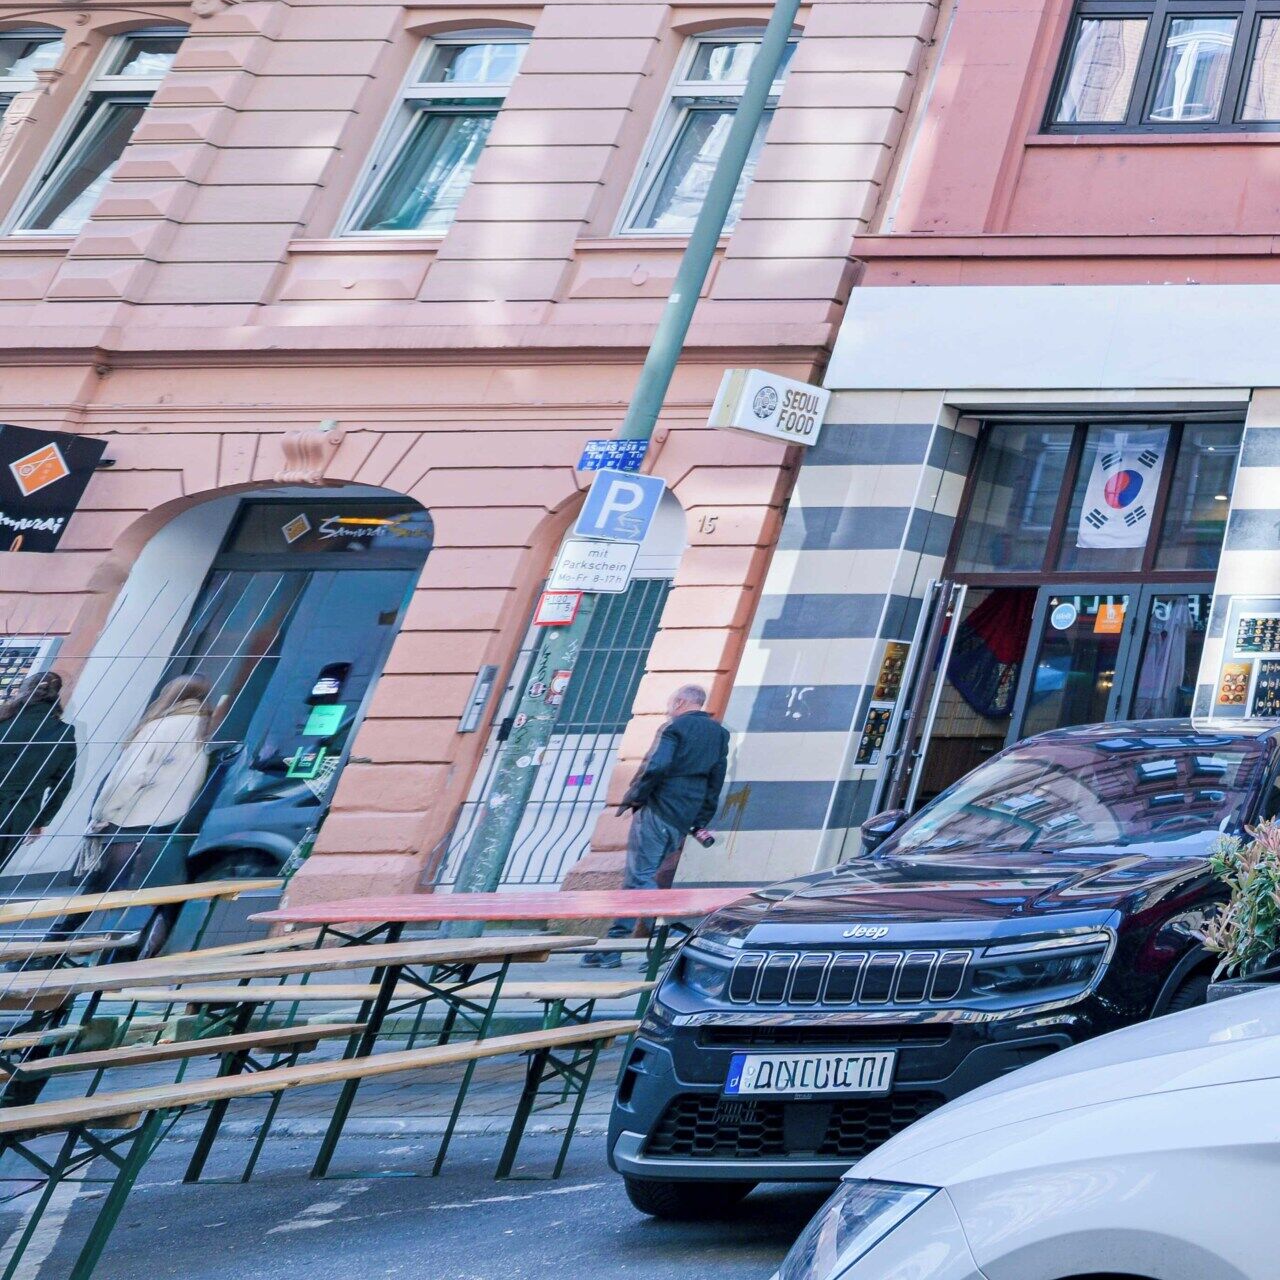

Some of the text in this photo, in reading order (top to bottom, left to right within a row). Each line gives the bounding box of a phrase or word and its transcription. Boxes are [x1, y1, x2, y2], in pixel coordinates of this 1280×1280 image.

[782, 389, 820, 416] SEOUL
[776, 408, 815, 436] FOOD
[594, 480, 645, 529] P
[697, 514, 718, 535] 15
[588, 549, 608, 558] mit
[563, 560, 626, 571] Parkschein
[842, 923, 889, 941] Jeep
